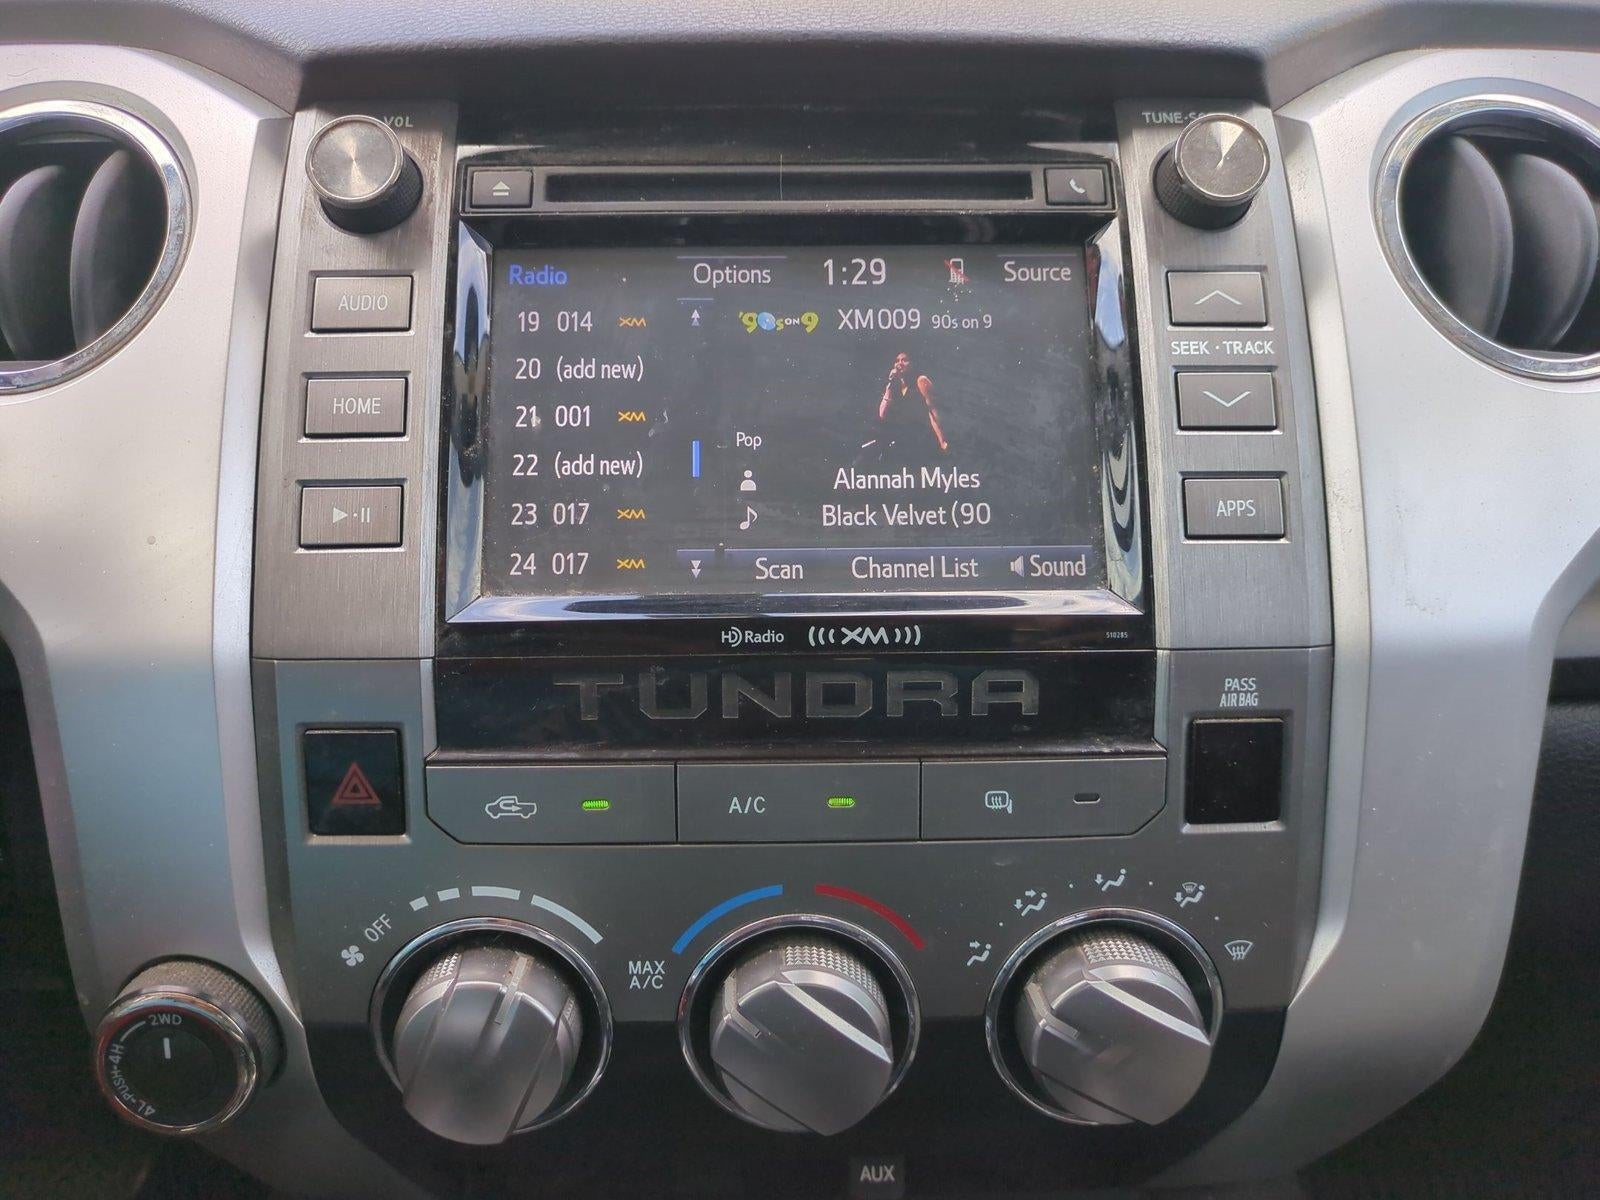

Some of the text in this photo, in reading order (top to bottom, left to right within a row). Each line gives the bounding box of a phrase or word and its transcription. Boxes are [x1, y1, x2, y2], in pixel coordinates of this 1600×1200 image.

[383, 116, 414, 128] VOL
[508, 264, 568, 286] Radio
[692, 263, 772, 288] Options
[823, 258, 887, 286] 1:29
[1003, 261, 1073, 283] Source
[338, 294, 389, 311] AUDIO
[517, 311, 540, 332] 19
[556, 311, 593, 332] 014
[800, 311, 819, 333] 9
[931, 314, 959, 330] 90s
[962, 317, 980, 330] on
[983, 314, 993, 330] 9
[1171, 341, 1275, 355] SEEK TRACK
[514, 355, 644, 382] 20 (add new)
[332, 397, 382, 415] HOME
[515, 405, 538, 428] 21
[554, 405, 591, 427] 001
[736, 431, 762, 451] Pop
[512, 451, 643, 478] 22 (add new)
[833, 467, 981, 493] Alannah Myles
[510, 503, 538, 526] 23
[552, 503, 590, 525] 017
[821, 500, 992, 529] Black Velvet (90
[1216, 500, 1256, 517] APPS
[509, 553, 536, 576] 24
[551, 552, 589, 575] 017
[754, 557, 804, 580] Scan
[850, 556, 980, 579] Channel List
[1029, 554, 1087, 577] Sound
[744, 629, 785, 643] Radio
[553, 670, 1040, 720] TUNDRA
[1224, 677, 1257, 692] PASS
[728, 796, 766, 814] A/C
[364, 913, 393, 942] OFF
[628, 960, 666, 976] MAX
[629, 974, 664, 990] A/C
[148, 1013, 182, 1026] 2WD
[860, 1165, 895, 1182] AUX
